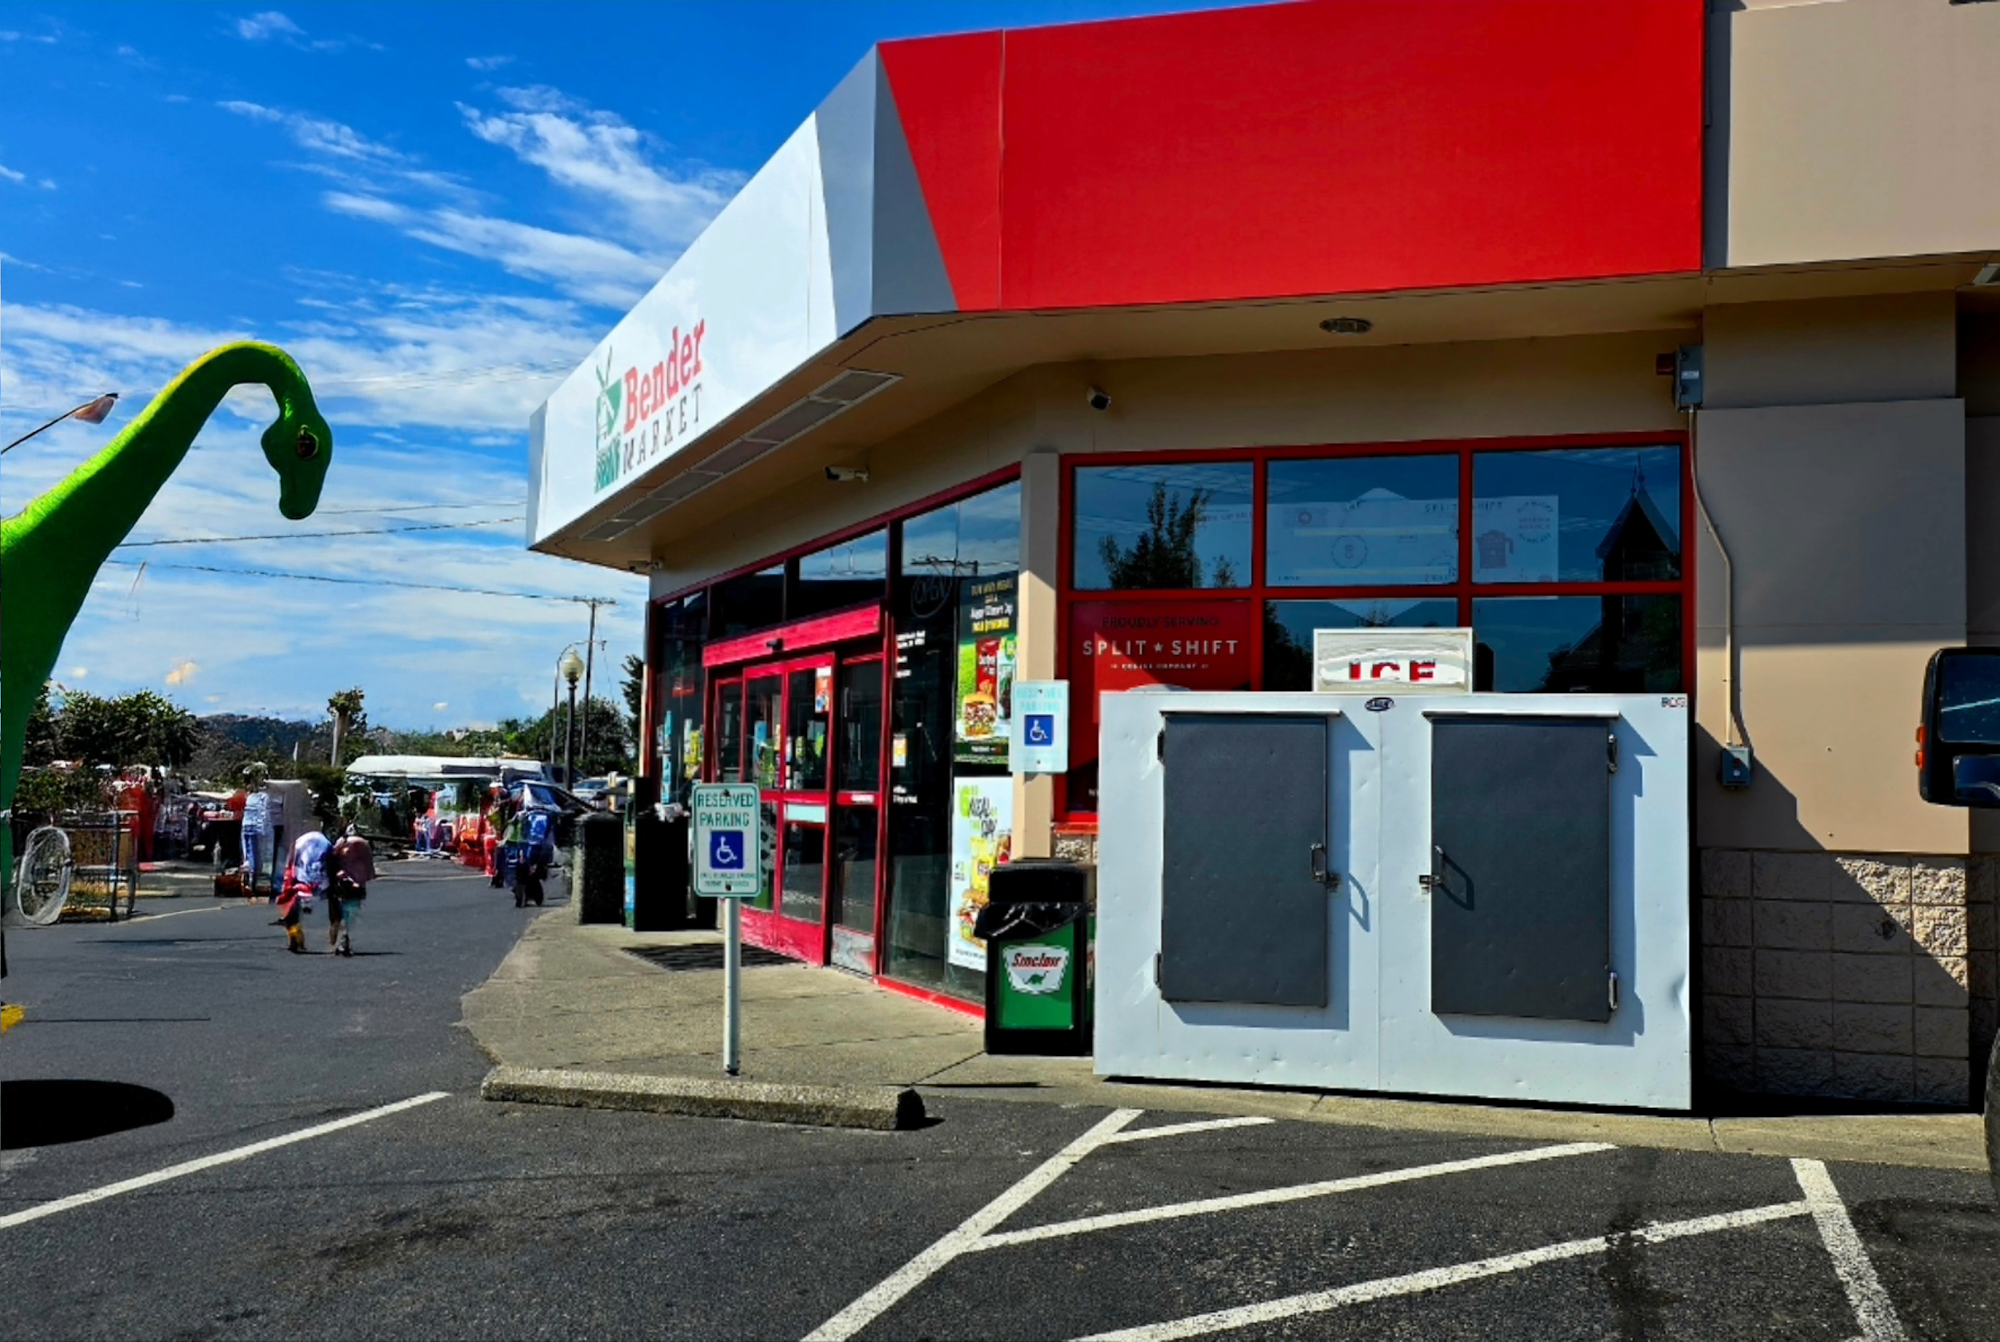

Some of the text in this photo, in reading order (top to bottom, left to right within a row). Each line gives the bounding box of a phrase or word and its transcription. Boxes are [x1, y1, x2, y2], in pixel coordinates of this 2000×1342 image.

[624, 318, 705, 435] Bender
[623, 383, 703, 474] MARKET
[1102, 615, 1219, 629] PROUDLY SERVING
[1083, 640, 1238, 655] SPLIT SHIFT
[1016, 688, 1064, 698] RESEVED
[1020, 701, 1060, 711] PARING
[697, 792, 754, 807] RESERVED
[700, 812, 750, 827] PARKING
[1011, 952, 1062, 967] Sinclair
